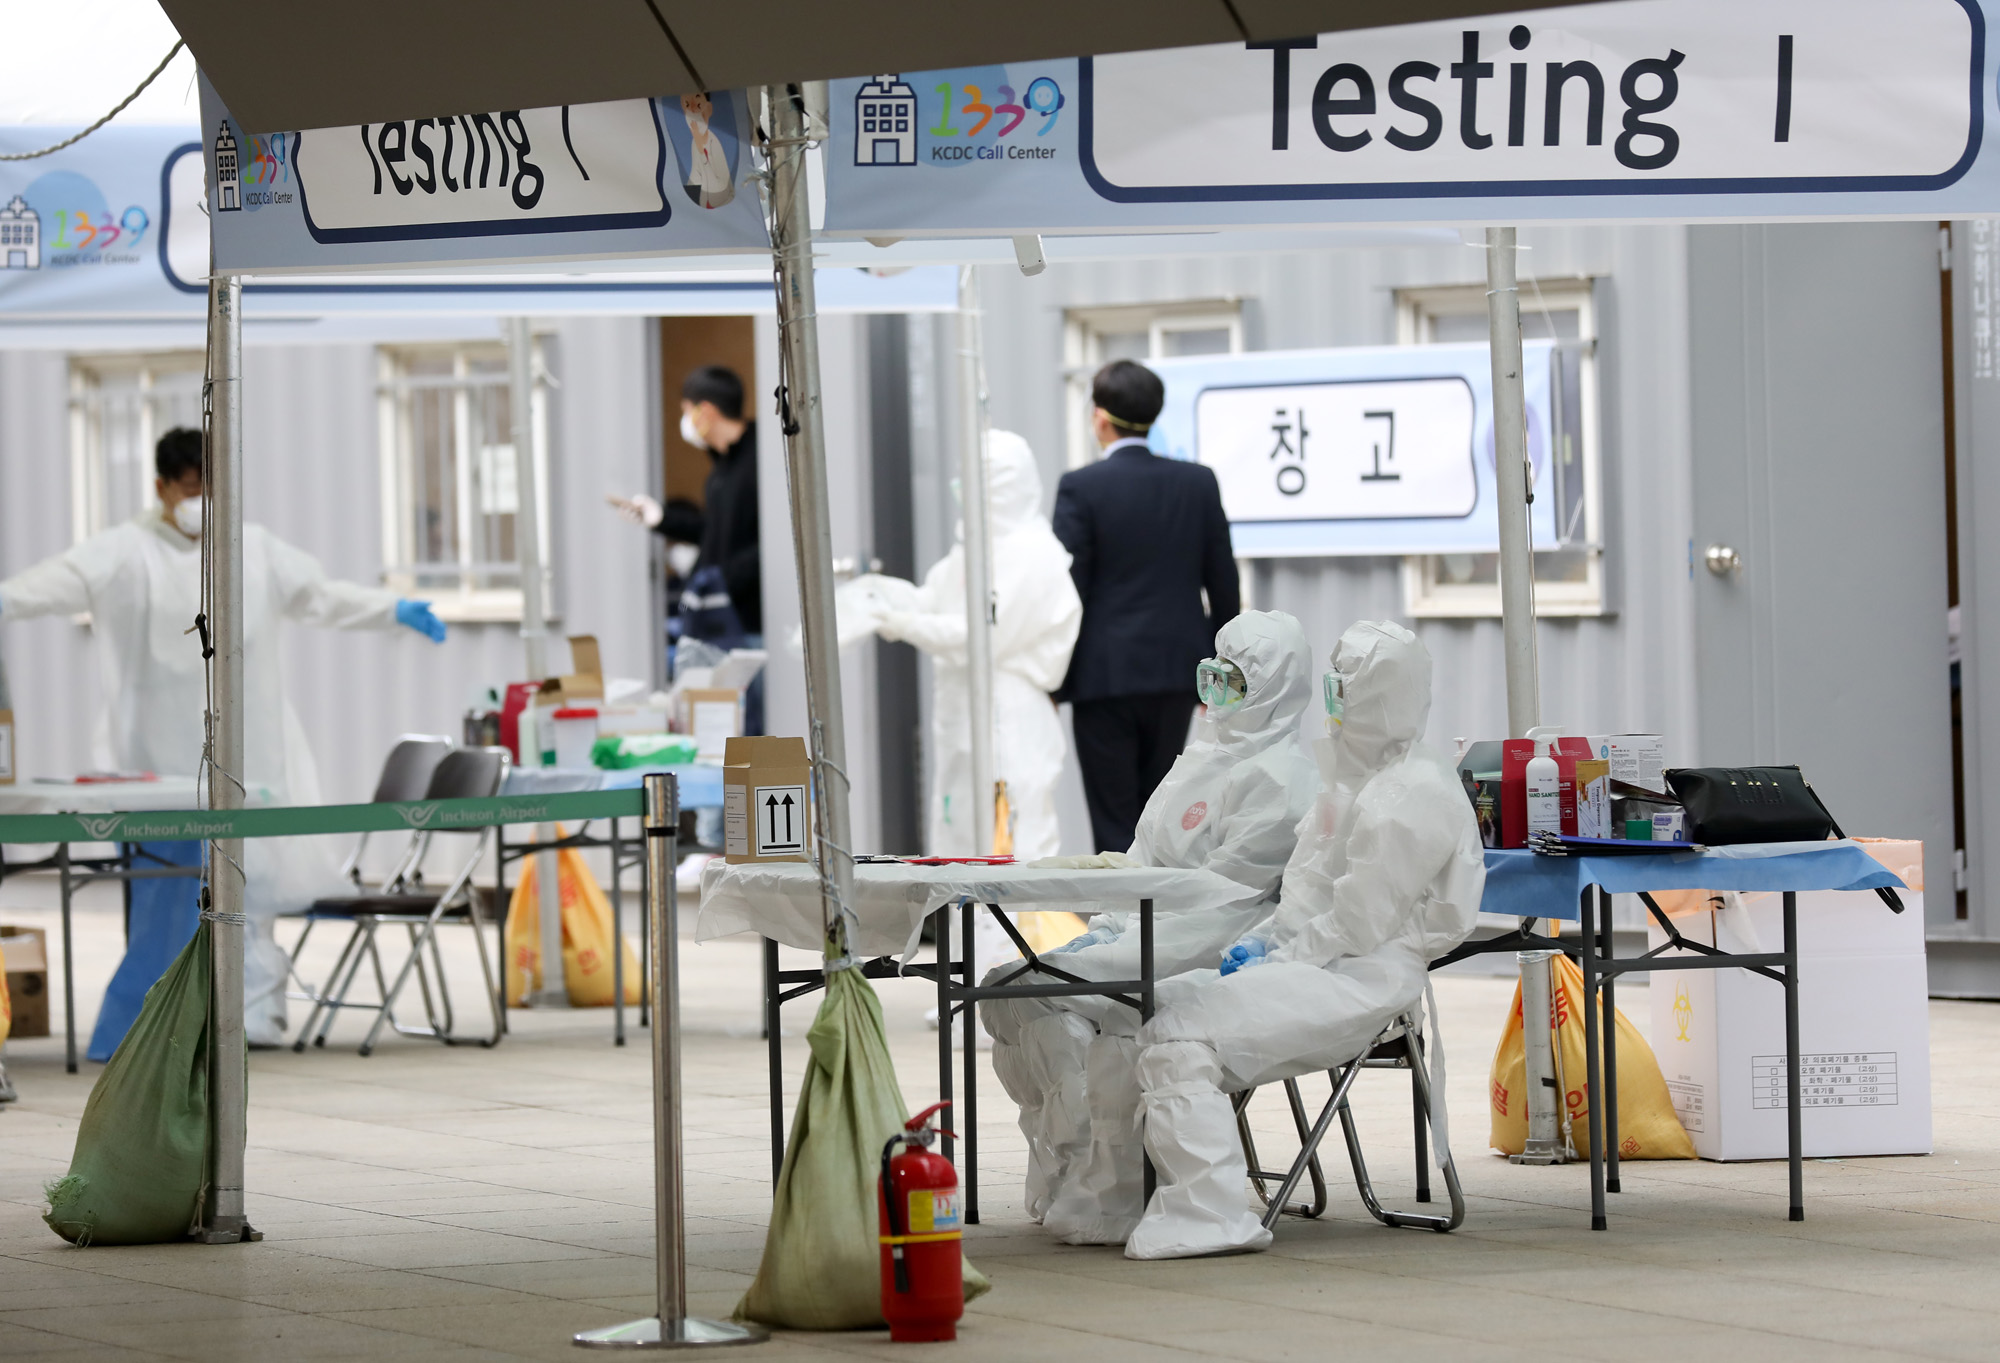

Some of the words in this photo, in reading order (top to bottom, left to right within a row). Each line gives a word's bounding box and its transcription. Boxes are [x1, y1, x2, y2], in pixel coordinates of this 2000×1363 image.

[1245, 25, 1686, 170] Testing
[929, 77, 1065, 137] 1339
[931, 146, 974, 160] KCDC
[977, 145, 1004, 160] Call
[1007, 145, 1056, 160] Center
[246, 192, 262, 205] KCDC
[263, 191, 273, 204] Call
[274, 192, 293, 203] Center
[49, 206, 150, 250] 1339
[441, 808, 494, 822] Incheon
[498, 806, 547, 820] Airport
[123, 823, 179, 837] Incheon
[183, 822, 233, 836] Airport
